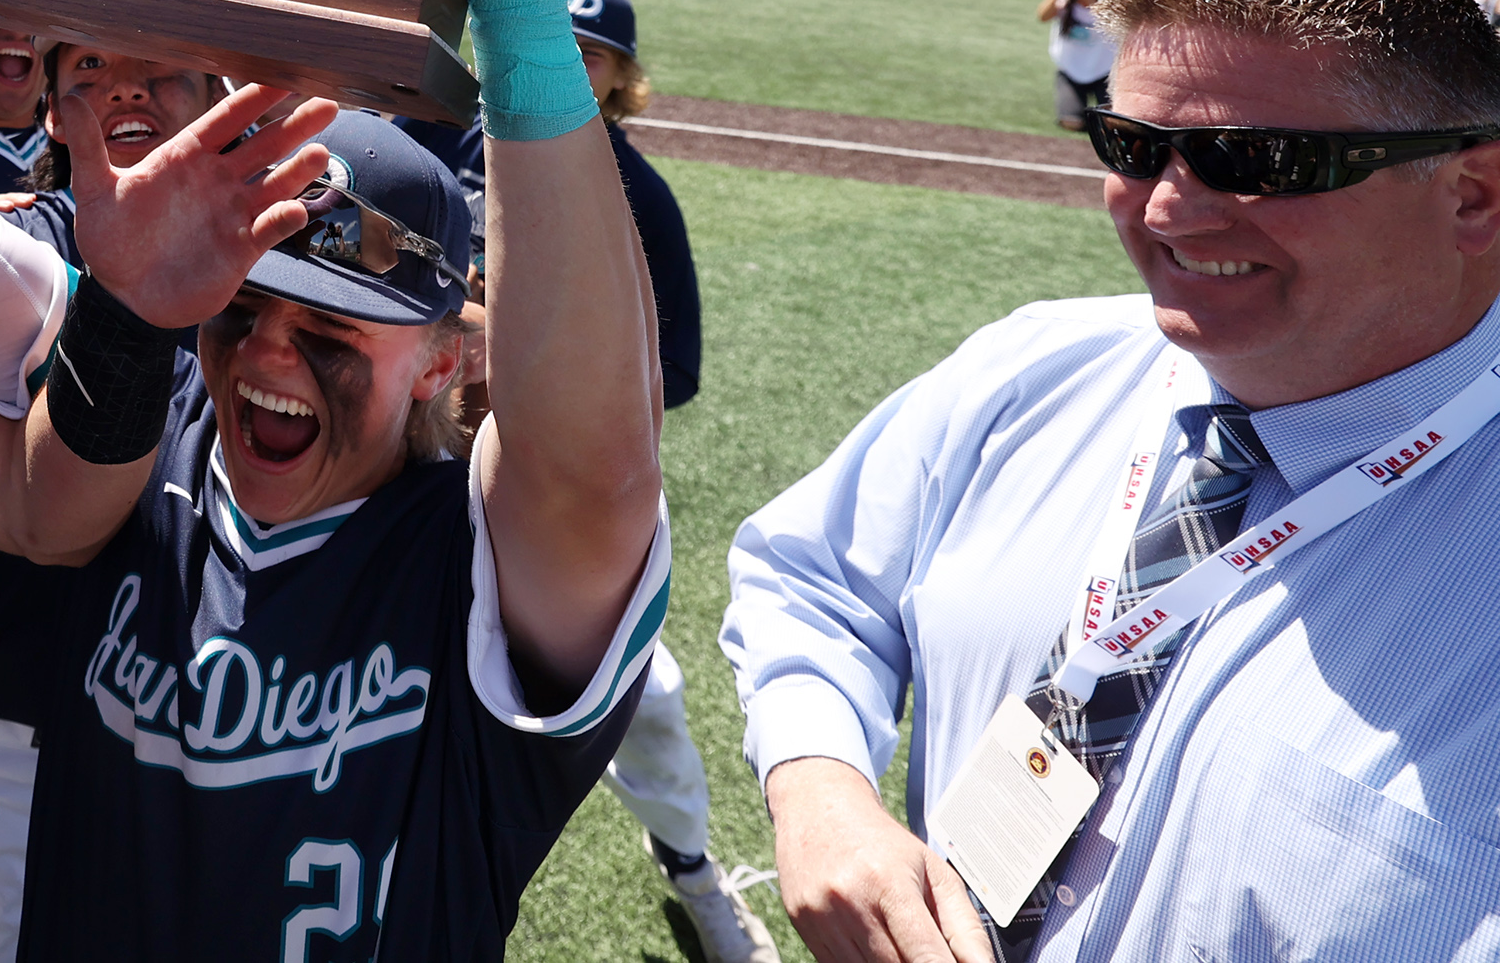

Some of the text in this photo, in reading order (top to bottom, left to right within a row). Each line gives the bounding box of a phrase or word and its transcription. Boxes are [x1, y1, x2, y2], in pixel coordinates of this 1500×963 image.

[1122, 453, 1151, 511] UHSAA
[1370, 430, 1444, 480] UHSAA
[1231, 520, 1299, 570] UHSAA
[1103, 607, 1169, 654] UHSAA
[184, 635, 400, 794] Diego
[279, 835, 400, 963] 2
